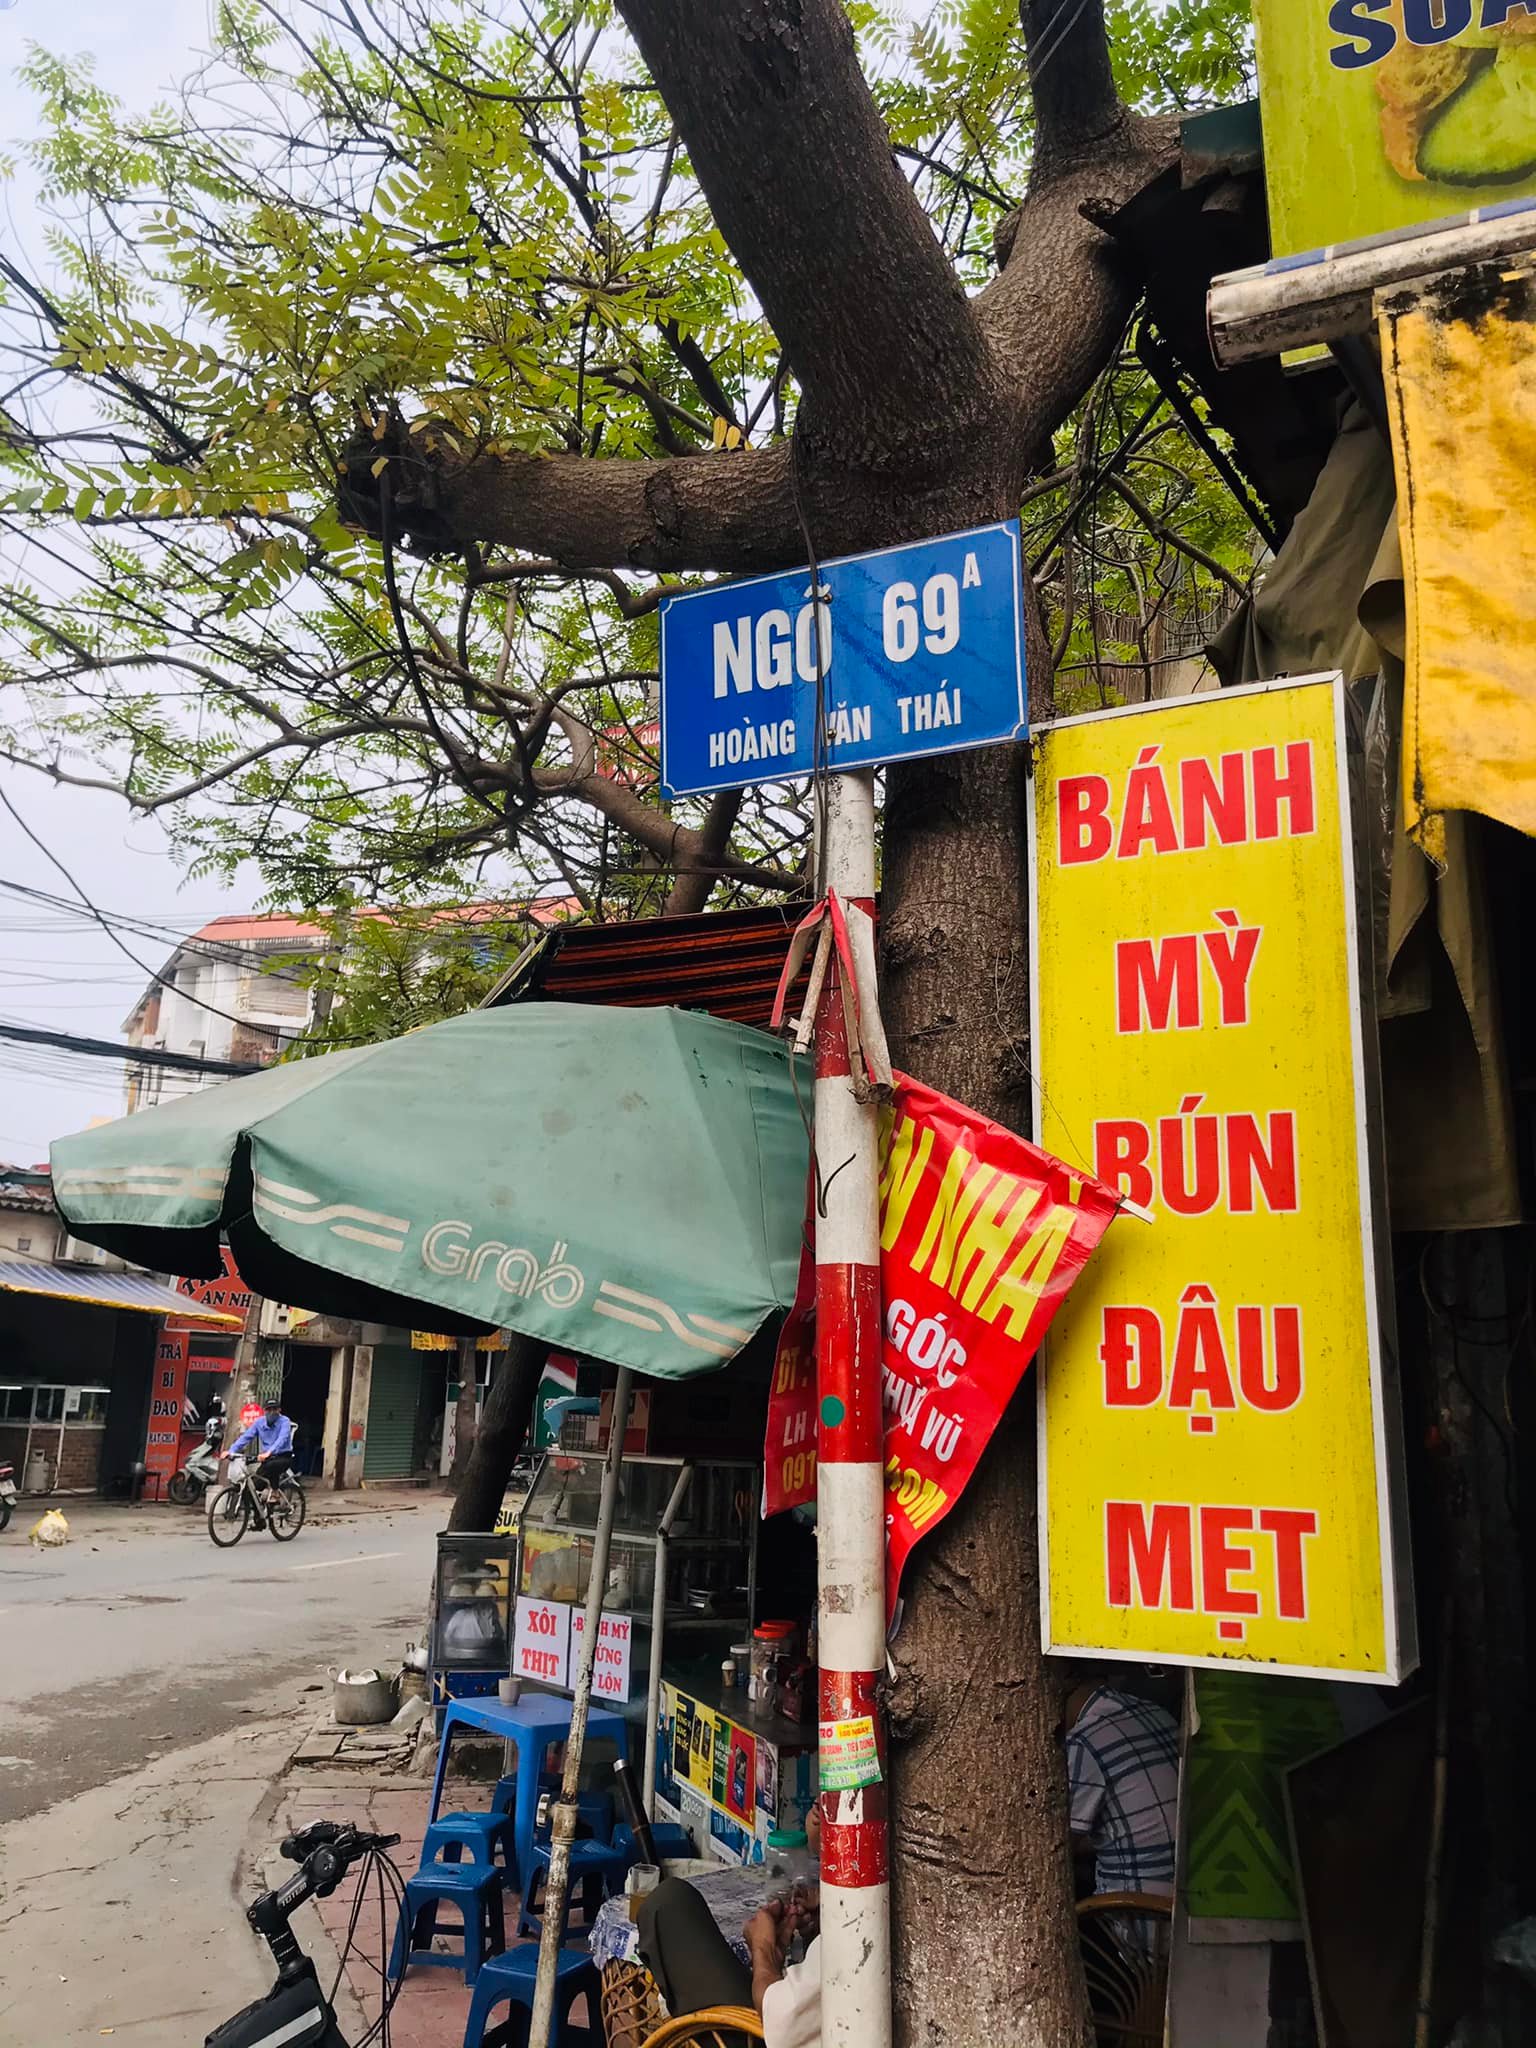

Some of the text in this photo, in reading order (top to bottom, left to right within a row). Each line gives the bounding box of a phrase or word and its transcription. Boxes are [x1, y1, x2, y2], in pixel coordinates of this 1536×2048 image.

[709, 717, 796, 768] HOÀNG
[897, 679, 962, 734] THÁI
[1057, 740, 1316, 867] BÁNH
[1116, 908, 1263, 1034] MỲ
[1095, 1094, 1300, 1215] BÚN
[421, 1219, 585, 1309] Grab
[909, 1146, 1083, 1342] NHÀ
[886, 1298, 967, 1389] GÓC
[1099, 1283, 1303, 1435] ĐẬU
[920, 1406, 964, 1463] VŨ
[1105, 1501, 1318, 1641] MẸT
[521, 1647, 560, 1680] THỊT
[527, 1606, 557, 1637] XÔI
[597, 1671, 623, 1694] LỘN
